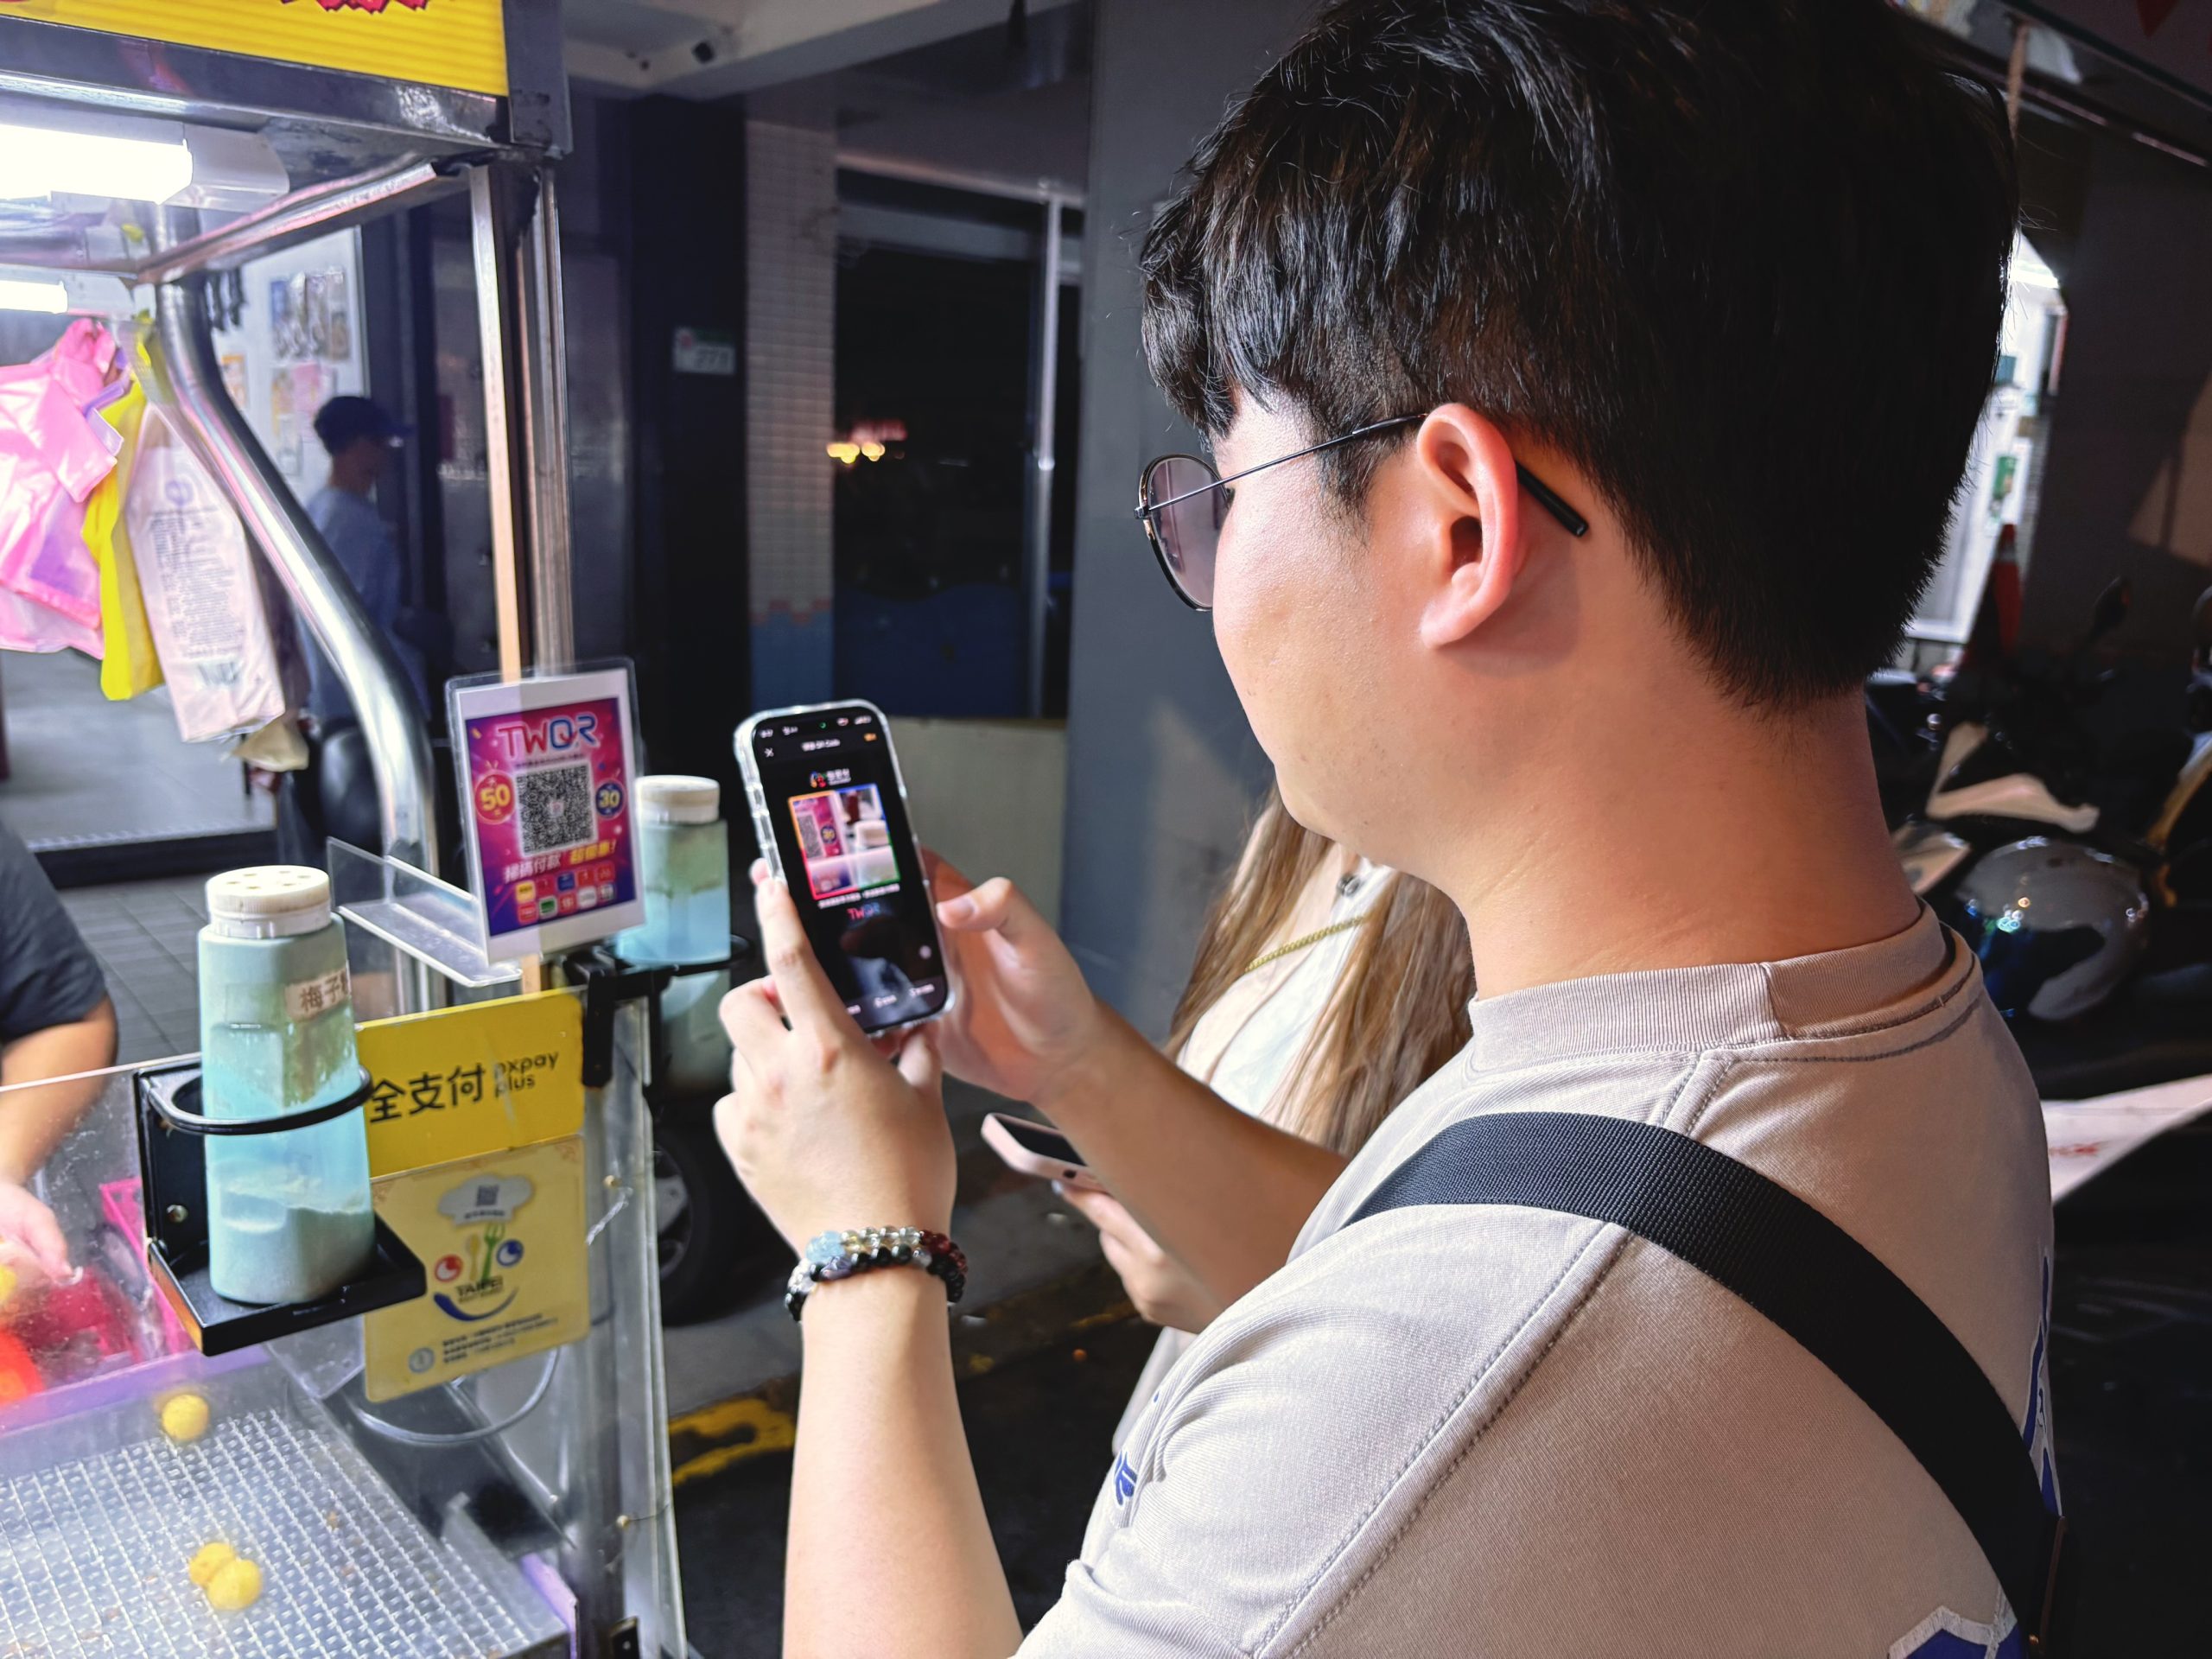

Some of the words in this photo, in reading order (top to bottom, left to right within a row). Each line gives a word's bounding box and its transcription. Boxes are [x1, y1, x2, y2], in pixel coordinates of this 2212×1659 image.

[496, 714, 599, 759] TWQR
[480, 783, 512, 811] 50
[598, 790, 621, 808] 30
[369, 1063, 486, 1123] 全支付
